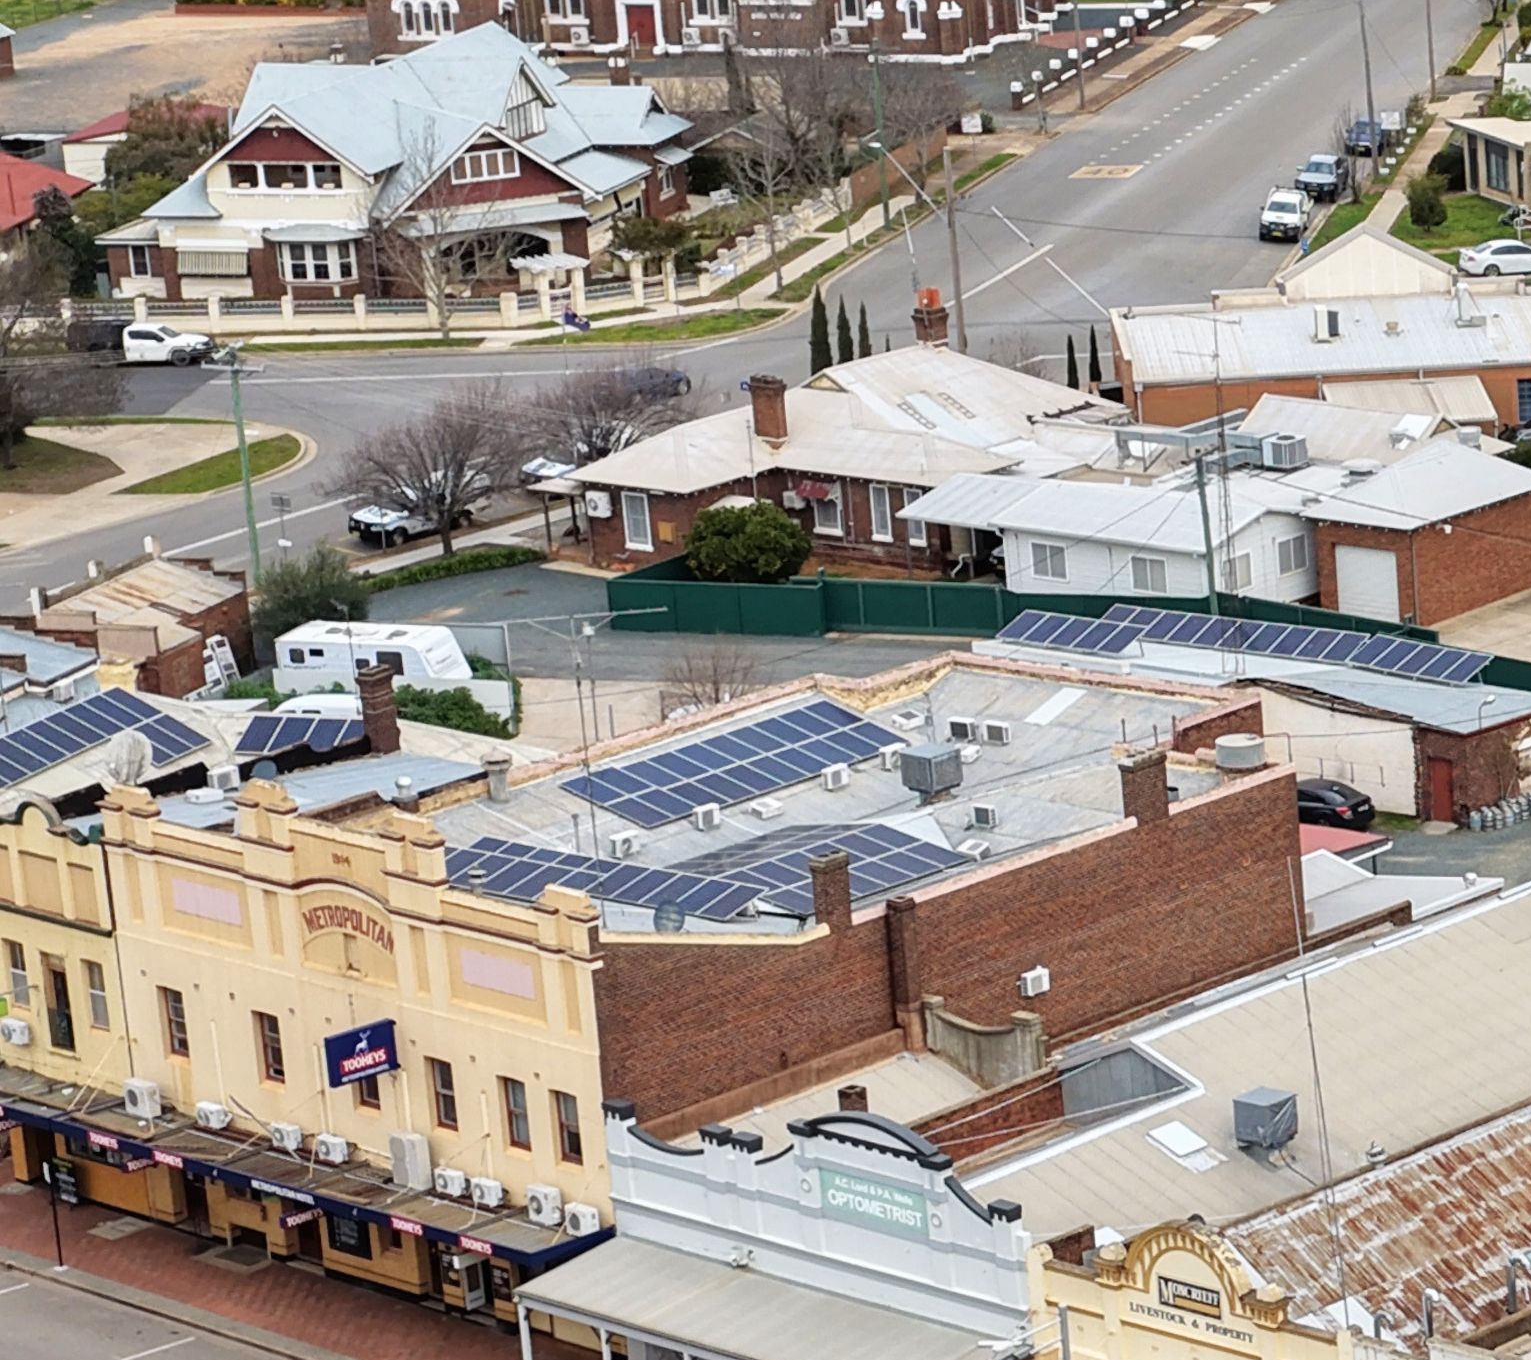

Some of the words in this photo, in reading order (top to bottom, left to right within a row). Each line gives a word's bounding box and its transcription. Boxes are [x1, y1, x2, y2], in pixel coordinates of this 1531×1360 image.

[302, 904, 395, 955] METROPOLITAN
[342, 1048, 387, 1073] TOOHEYS
[827, 1188, 923, 1228] OPTOMETRIST
[1129, 1301, 1186, 1326] LIVESTOCK
[1191, 1319, 1199, 1329] &
[1205, 1322, 1254, 1344] PROPERTY
